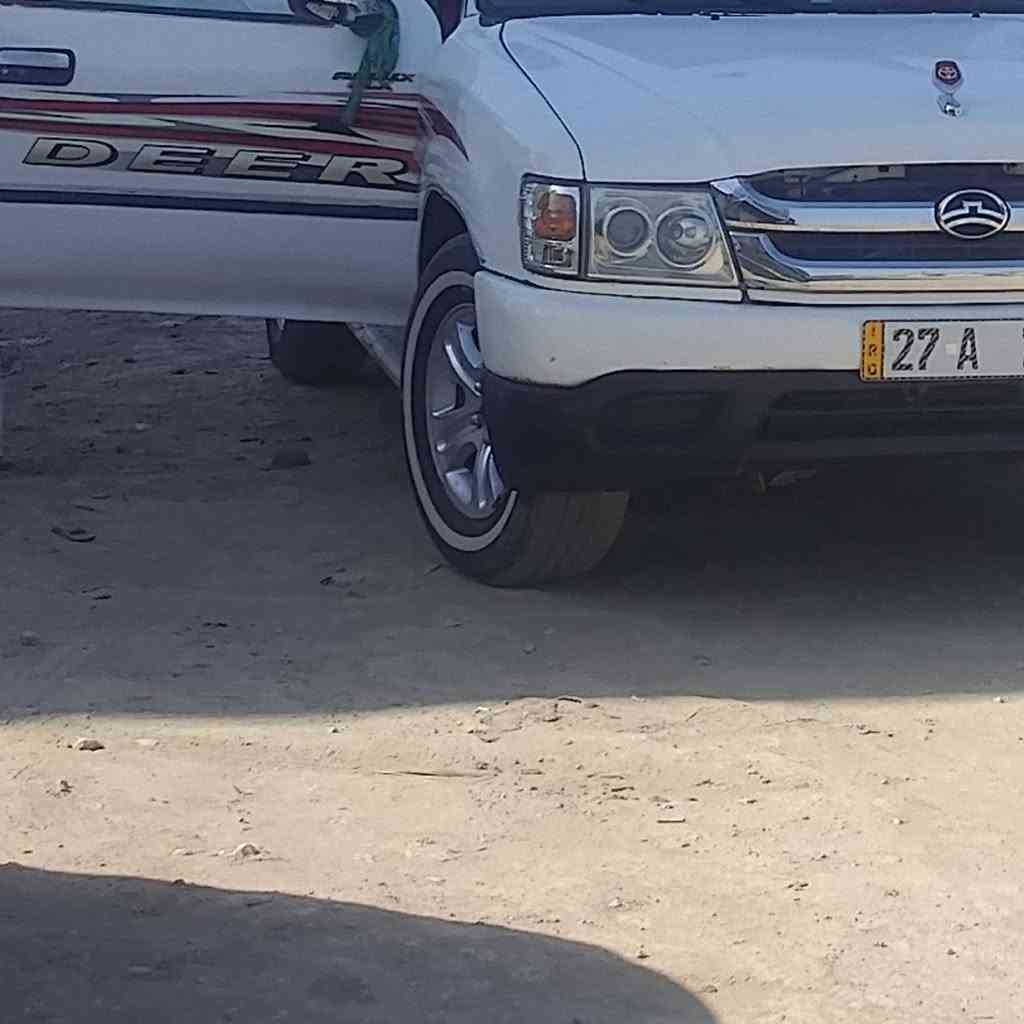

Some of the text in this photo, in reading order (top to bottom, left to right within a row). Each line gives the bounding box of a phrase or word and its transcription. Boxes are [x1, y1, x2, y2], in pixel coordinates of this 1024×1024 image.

[22, 136, 411, 189] DEER
[892, 328, 940, 371] 27
[957, 327, 979, 371] A
